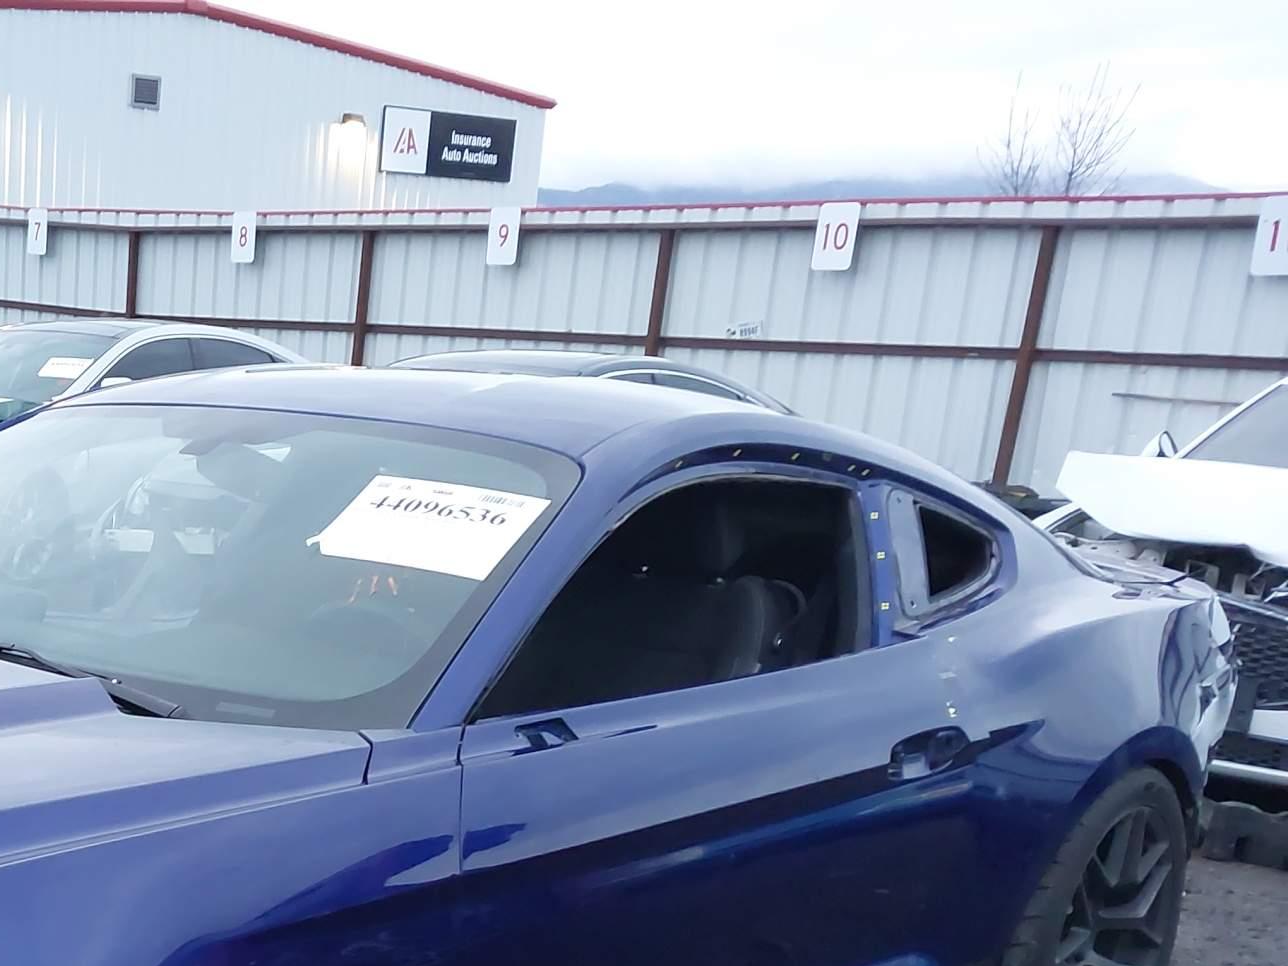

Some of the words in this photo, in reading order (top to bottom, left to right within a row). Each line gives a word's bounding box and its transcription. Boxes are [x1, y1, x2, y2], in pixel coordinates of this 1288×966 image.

[451, 130, 492, 149] Insurance
[441, 146, 462, 163] Auto
[462, 148, 498, 166] Auctions
[34, 221, 41, 241] 7
[239, 226, 248, 248] 8
[498, 223, 509, 247] 9
[822, 223, 849, 251] 10
[370, 495, 507, 527] 44096536
